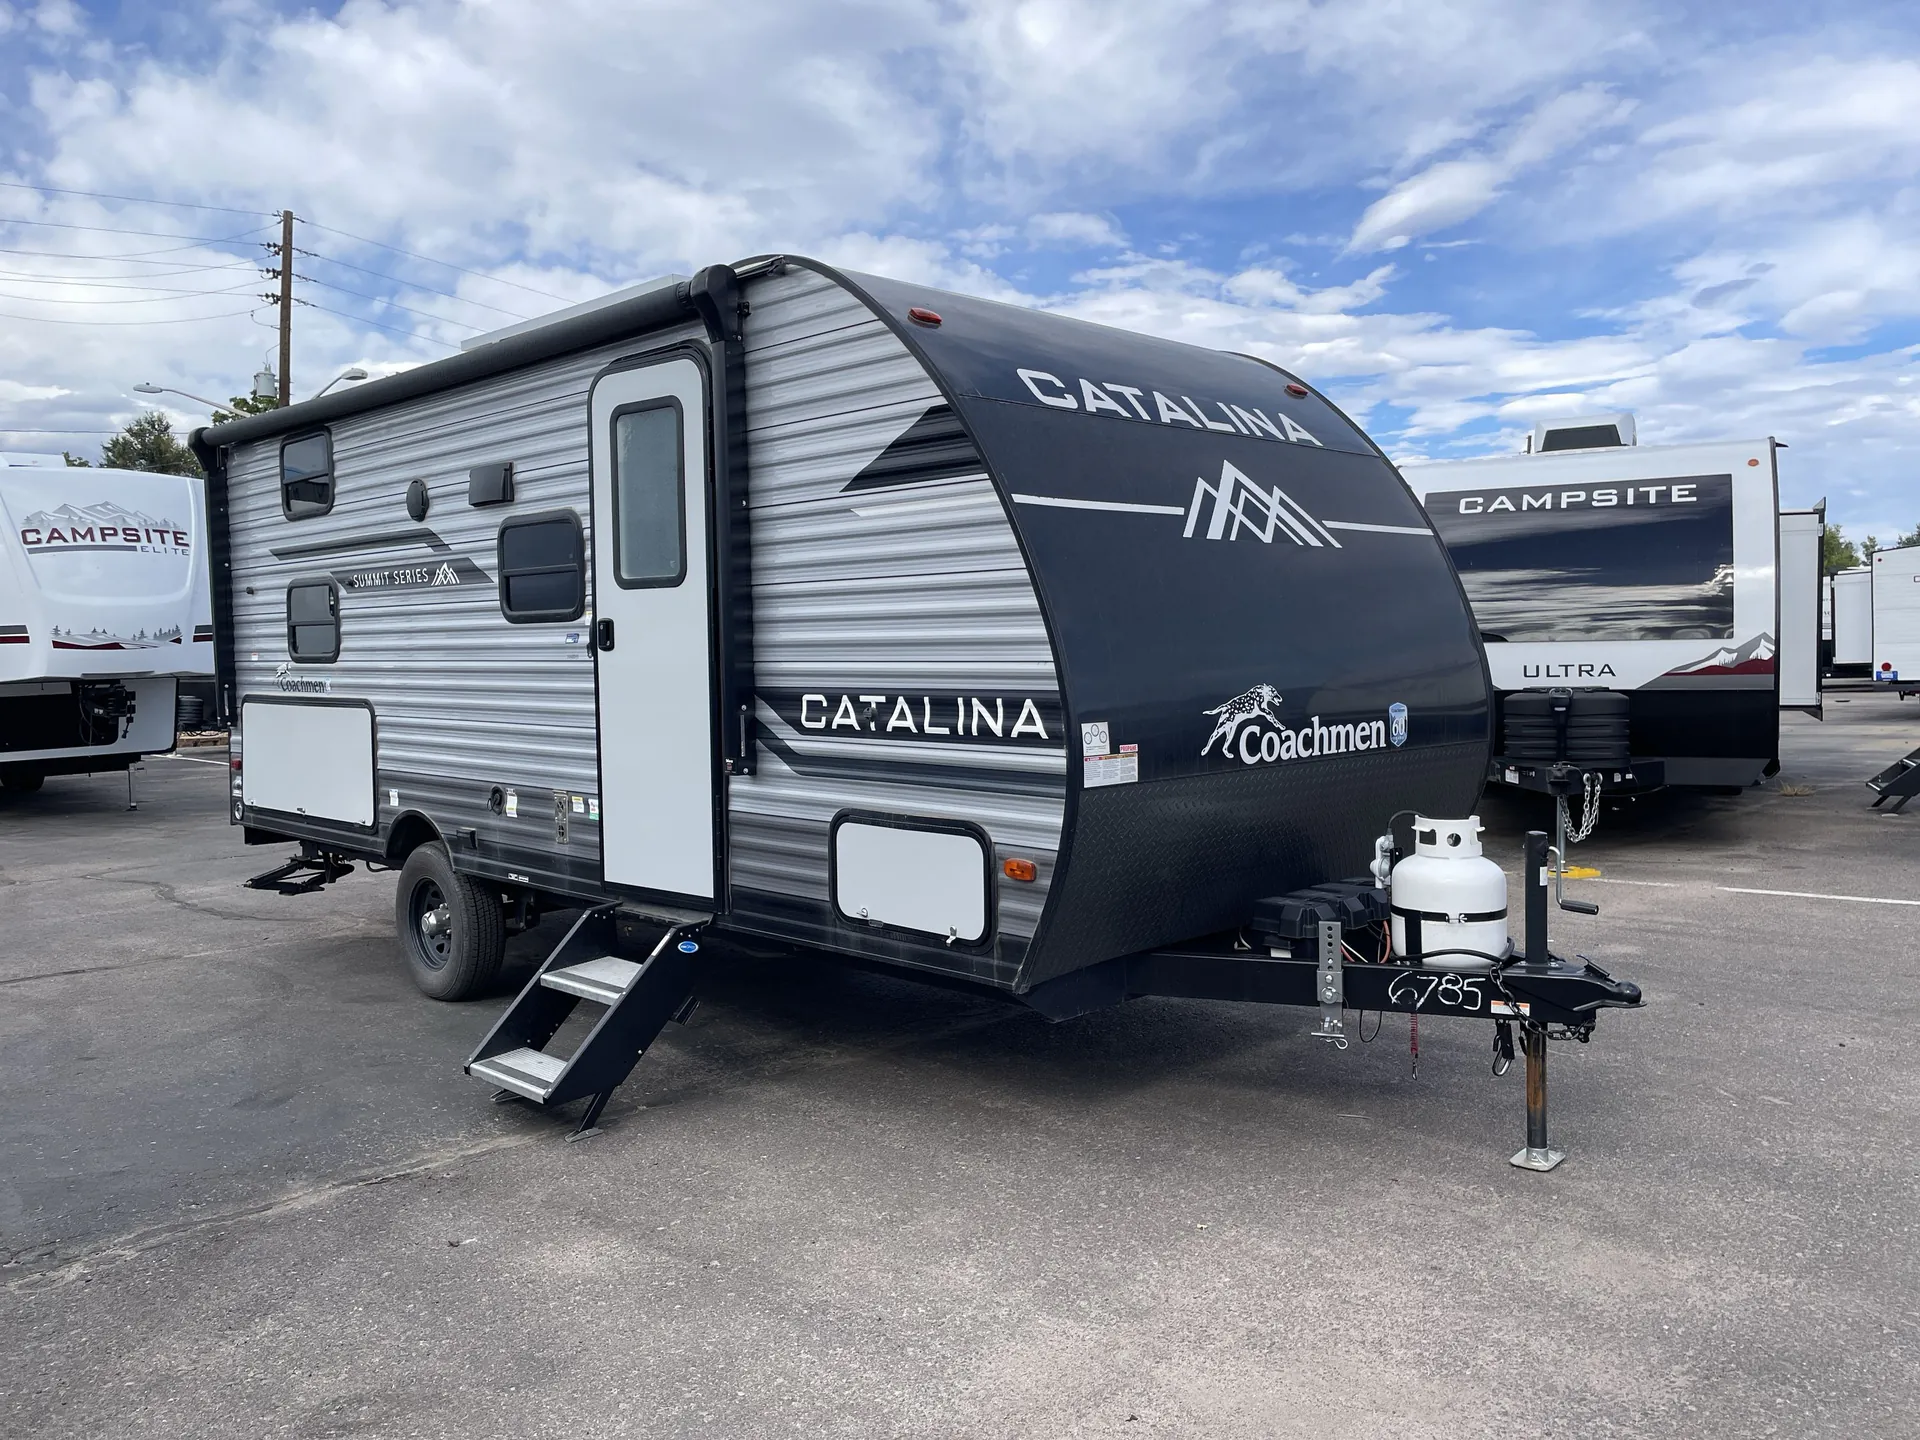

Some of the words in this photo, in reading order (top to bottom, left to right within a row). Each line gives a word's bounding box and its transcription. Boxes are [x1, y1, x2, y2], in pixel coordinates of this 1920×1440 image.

[1017, 368, 1323, 447] CATALINA
[1459, 484, 1697, 514] CAMPSITE
[21, 527, 190, 547] CAMPSITE
[140, 545, 189, 556] ELITE
[353, 571, 389, 588] SUMMIT
[393, 567, 429, 585] SERIES
[1523, 663, 1616, 678] ULTRA
[280, 676, 325, 693] Coachmen
[801, 693, 1049, 739] CATALINA
[1239, 715, 1387, 764] Coachmen
[1388, 971, 1486, 1010] 6785
